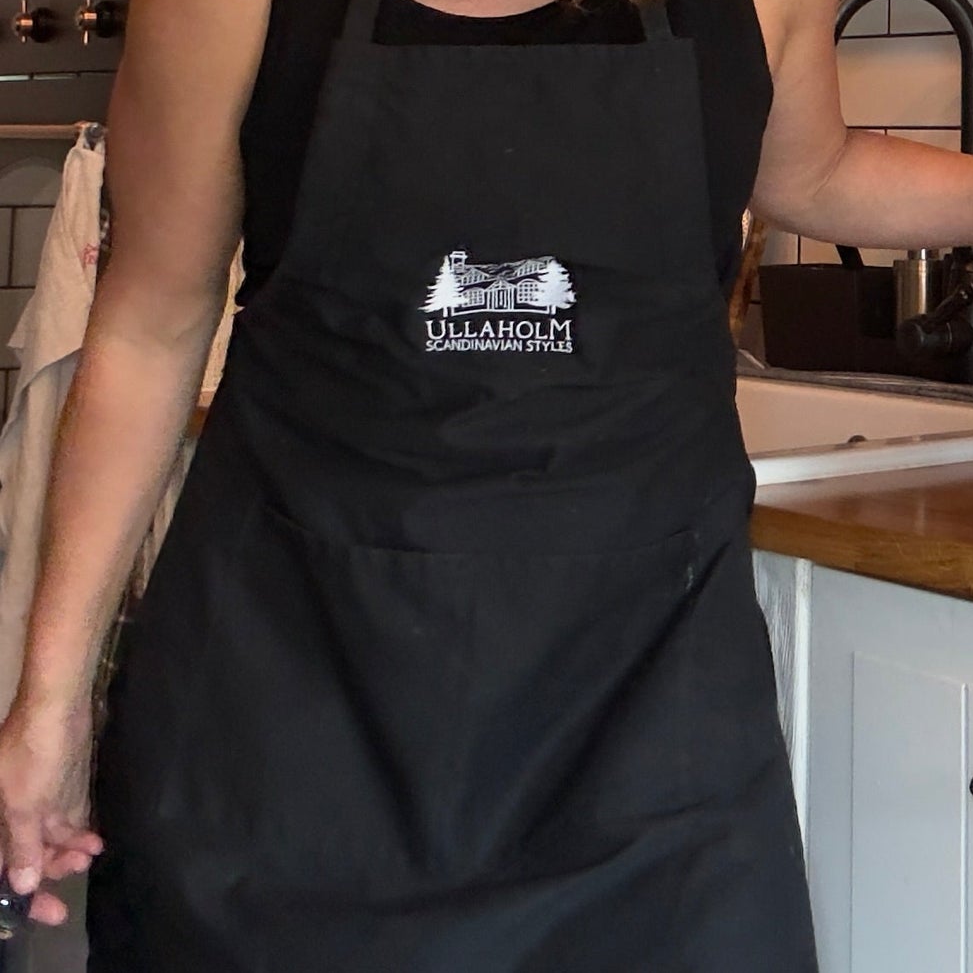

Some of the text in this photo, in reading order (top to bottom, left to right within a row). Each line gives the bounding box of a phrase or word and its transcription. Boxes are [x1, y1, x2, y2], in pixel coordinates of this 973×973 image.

[425, 319, 573, 341] ULLAHOLM
[425, 339, 573, 353] SCANDINAVIAN STYLES
